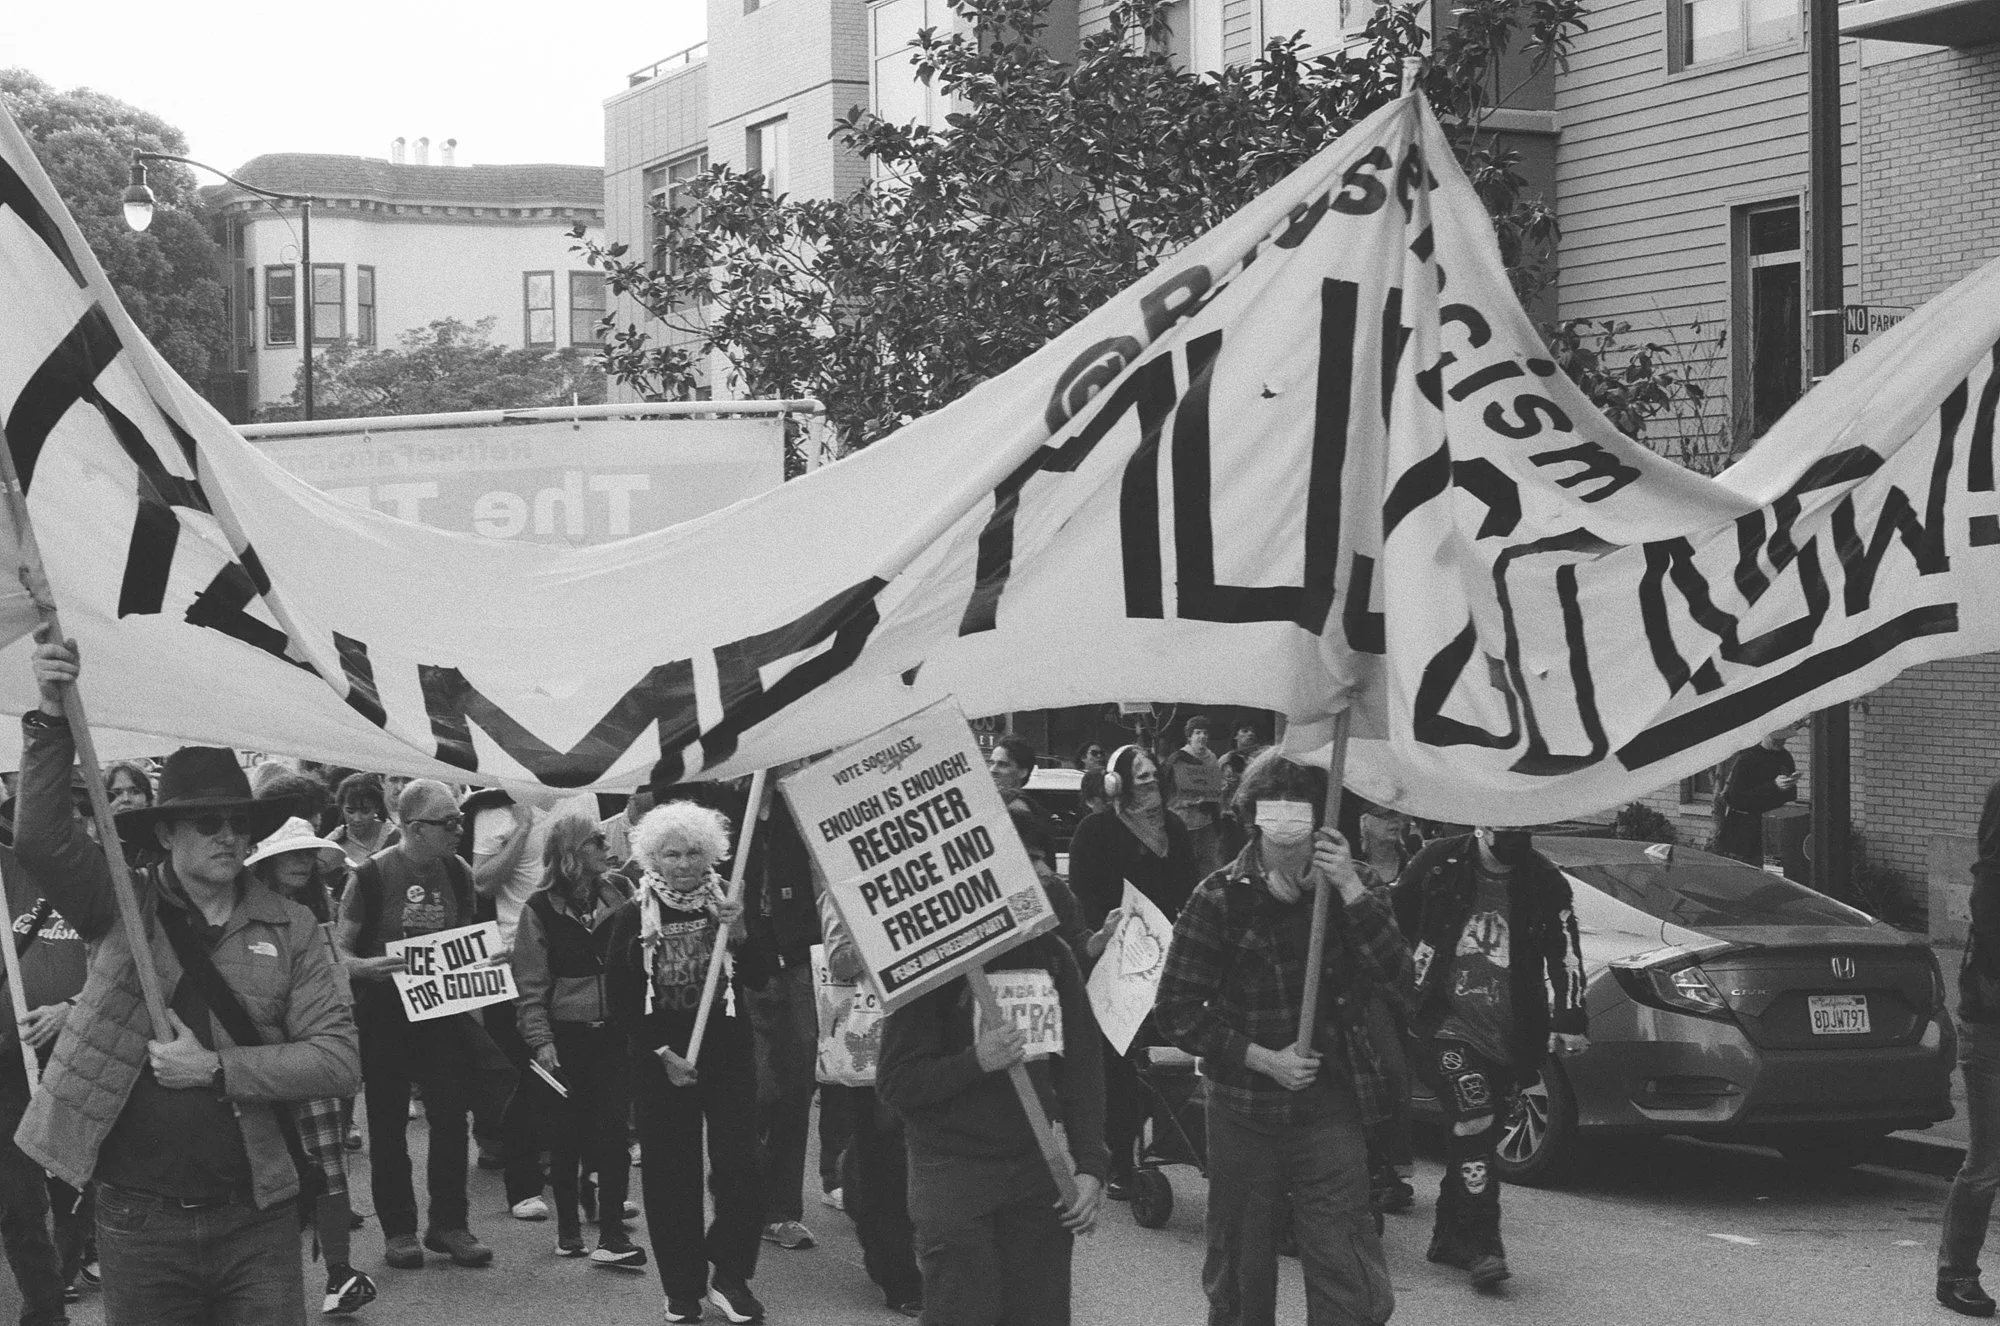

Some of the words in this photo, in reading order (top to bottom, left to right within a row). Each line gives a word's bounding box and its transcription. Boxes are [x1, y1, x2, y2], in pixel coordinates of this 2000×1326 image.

[1847, 309, 1865, 331] NO
[832, 762, 864, 786] VOTE
[863, 736, 917, 775] SOCIALIST
[818, 795, 885, 843] ENOUGH
[882, 786, 904, 811] IS
[901, 751, 972, 801] ENOUGH!
[848, 787, 972, 872] REGISTER
[859, 851, 944, 916] PEACE
[941, 825, 995, 876] AND
[882, 868, 1002, 951] FREEDOM
[404, 946, 436, 976] ICE
[441, 929, 488, 971] OUT
[405, 979, 444, 1014] FOR
[443, 969, 507, 1001] GOOD!
[1813, 1009, 1866, 1029] 8DJW797
